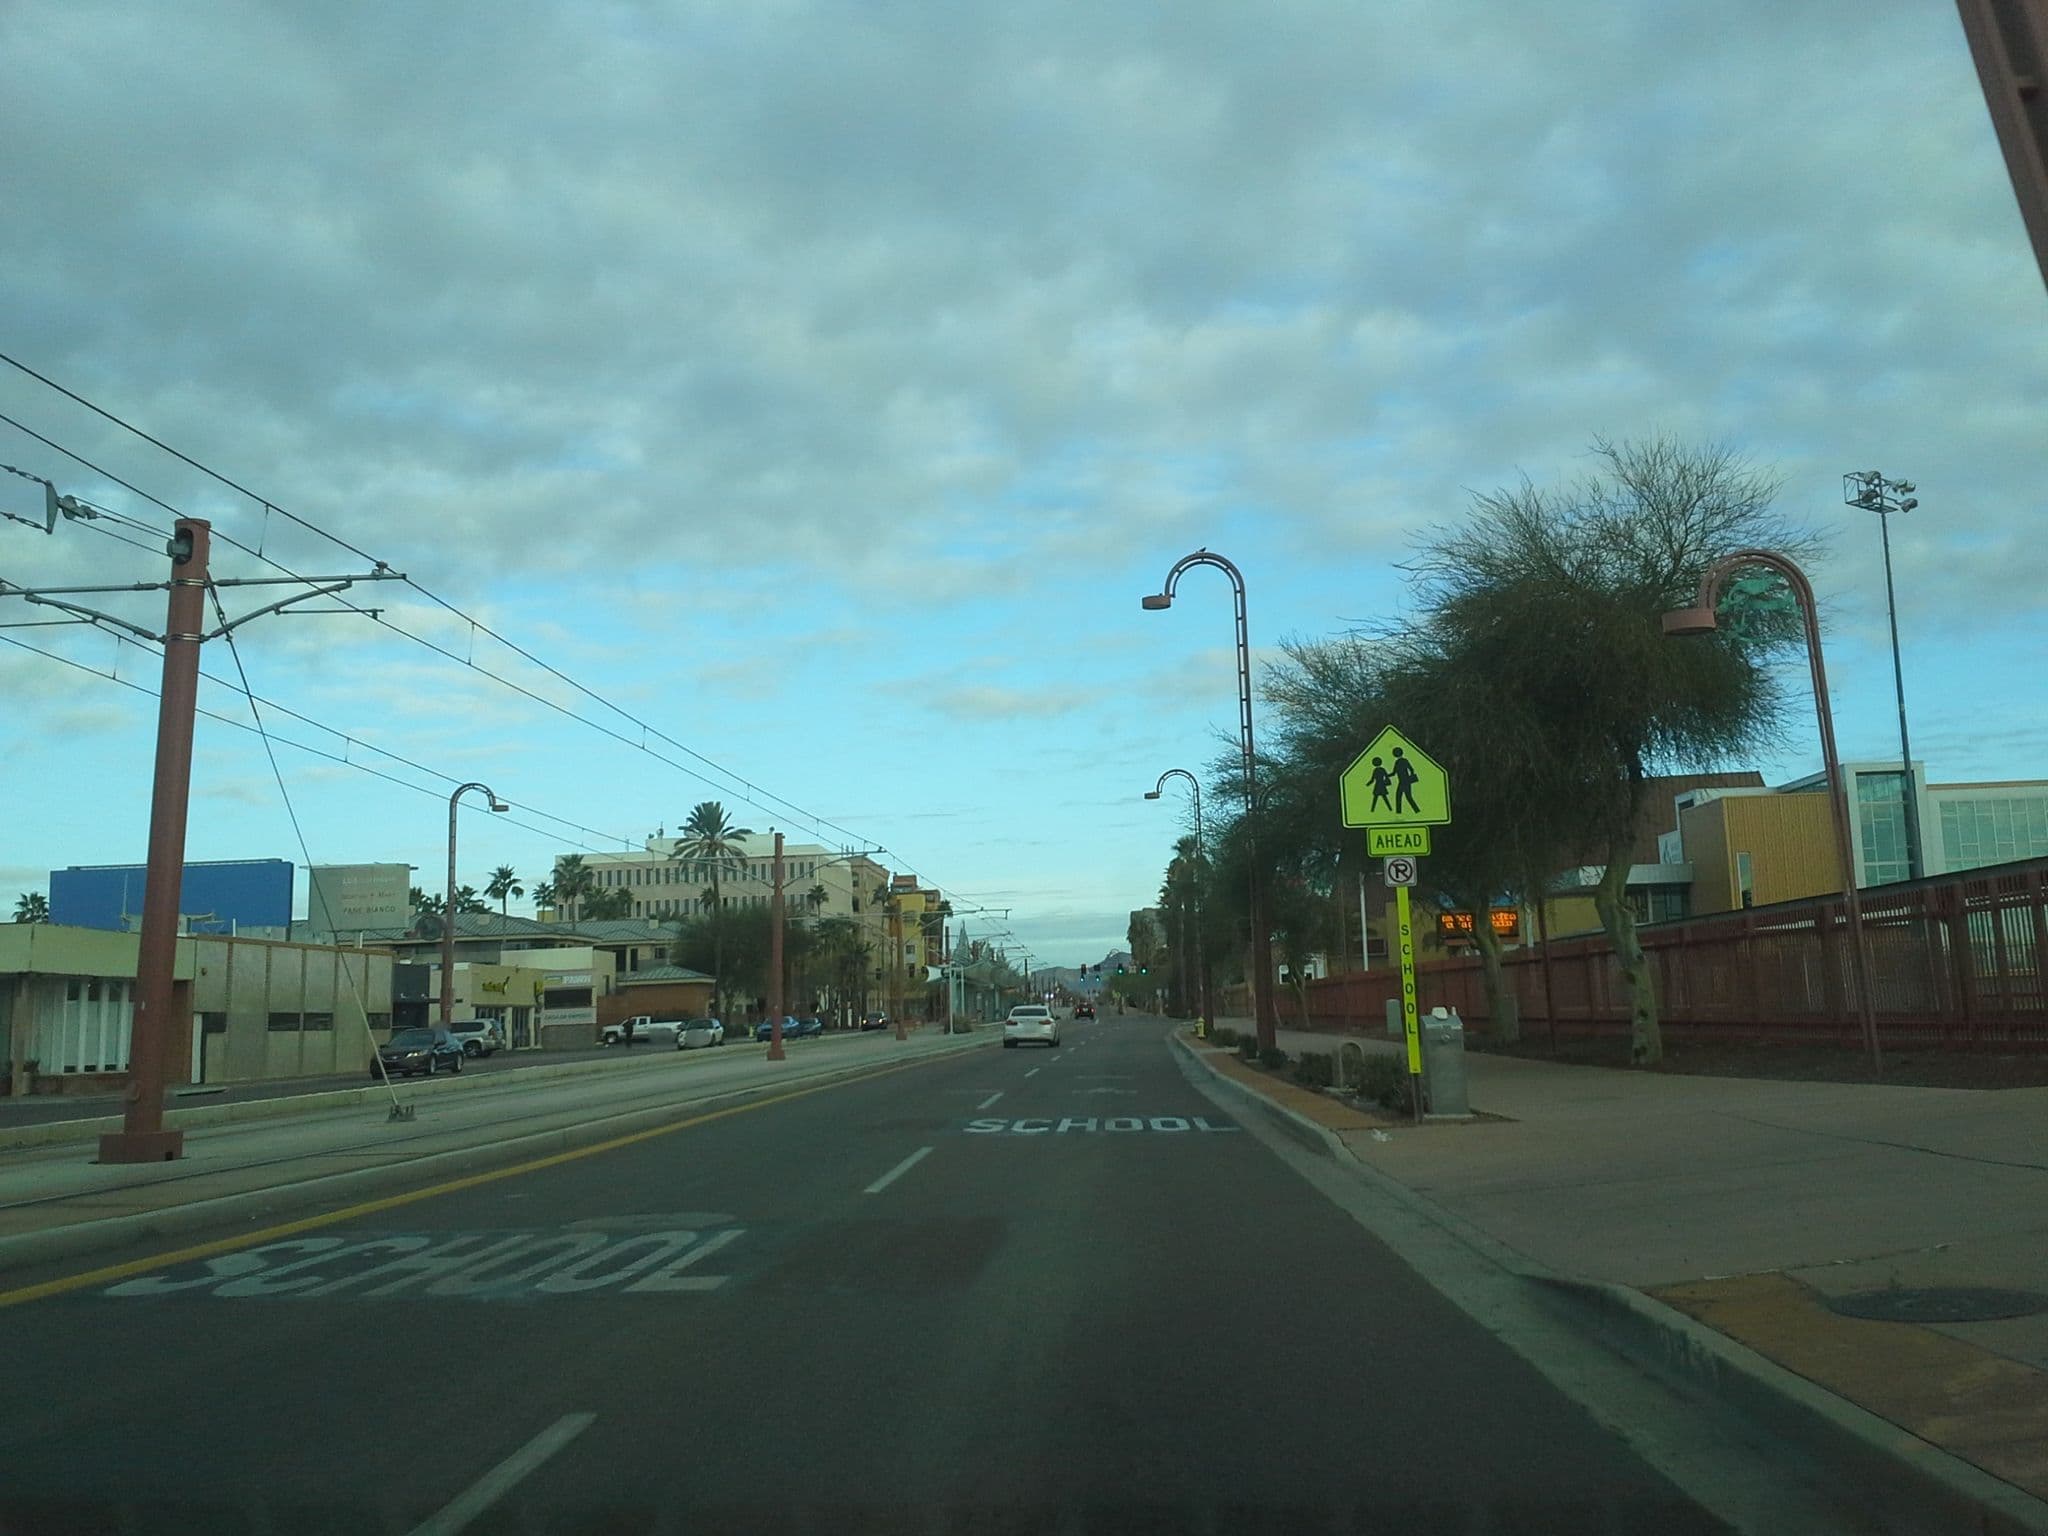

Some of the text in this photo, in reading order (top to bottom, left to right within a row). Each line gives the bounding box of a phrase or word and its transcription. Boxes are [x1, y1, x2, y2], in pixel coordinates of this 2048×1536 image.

[1376, 833, 1422, 849] AHEAD
[1401, 924, 1416, 1035] SCHOOL
[963, 1117, 1240, 1133] SCHOOL
[103, 1227, 746, 1297] SCHOOL
